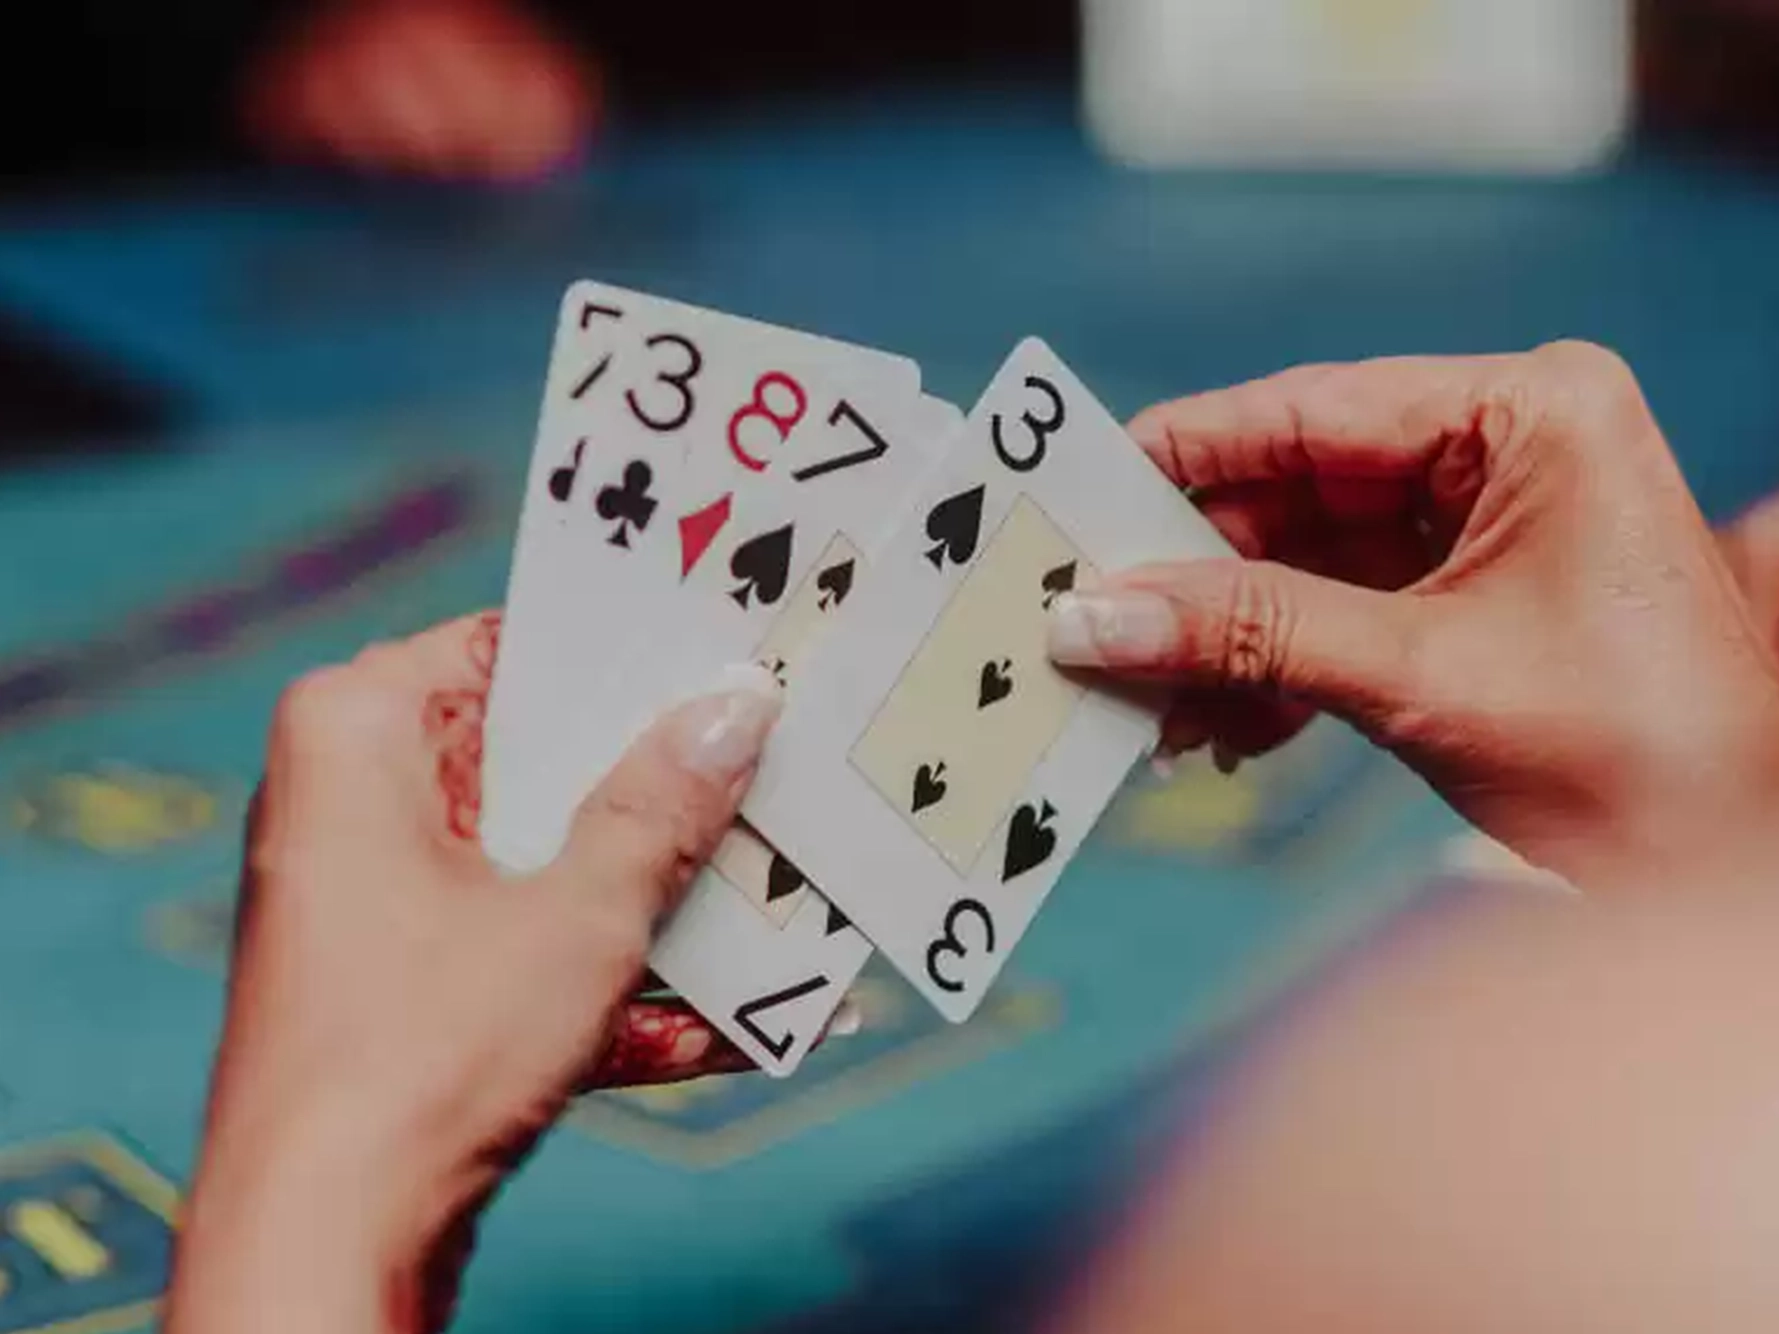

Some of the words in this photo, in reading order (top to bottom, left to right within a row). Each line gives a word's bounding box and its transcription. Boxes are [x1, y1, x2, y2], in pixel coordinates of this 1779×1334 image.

[569, 302, 622, 399] 7
[624, 334, 702, 431] 3
[727, 370, 807, 472] 8
[793, 399, 889, 482] 7
[991, 376, 1066, 472] 3
[926, 898, 995, 992] 3
[733, 974, 830, 1061] 7
